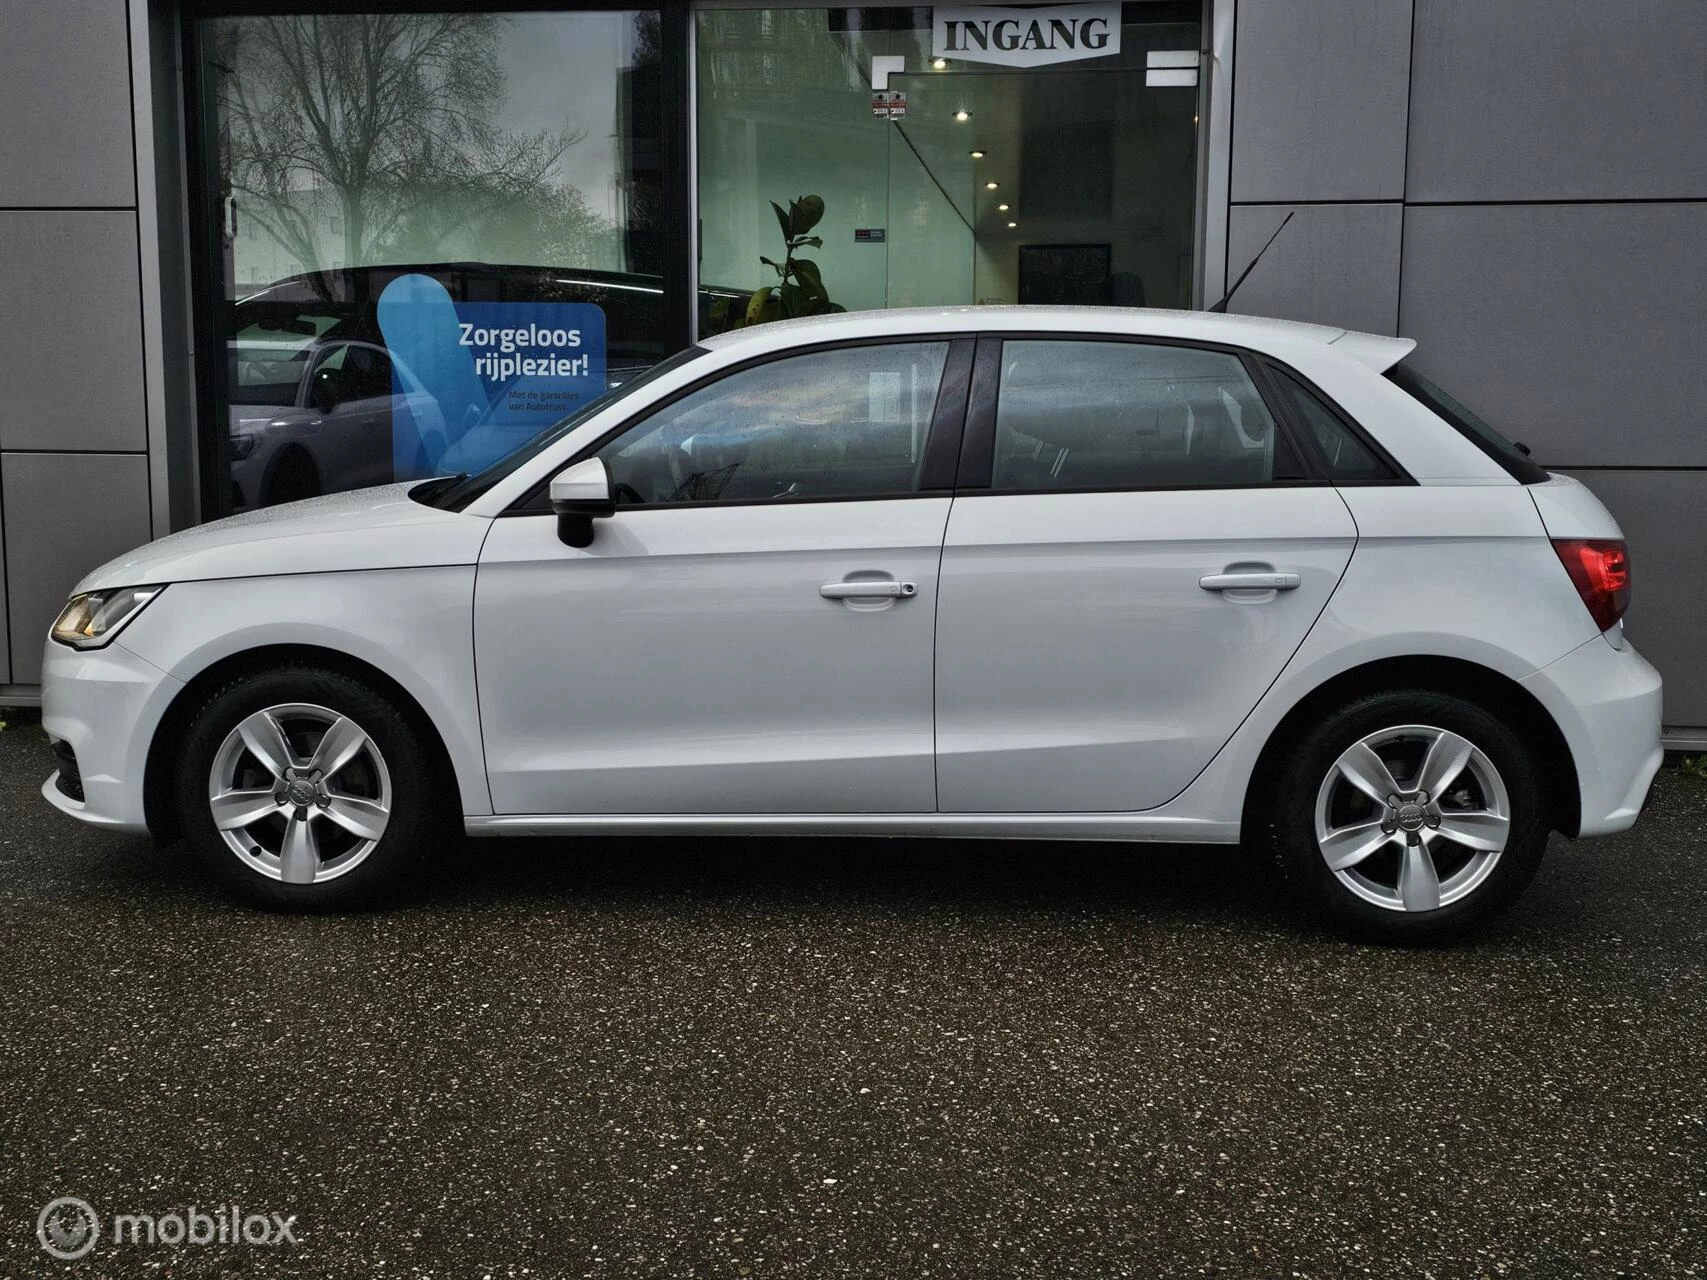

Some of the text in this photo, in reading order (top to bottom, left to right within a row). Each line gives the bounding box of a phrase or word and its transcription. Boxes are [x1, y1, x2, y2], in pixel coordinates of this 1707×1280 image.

[943, 17, 1110, 51] INGANG
[458, 323, 581, 352] Zorgeloos
[475, 352, 588, 382] rijplezier!
[509, 391, 525, 399] Met
[527, 391, 538, 399] de
